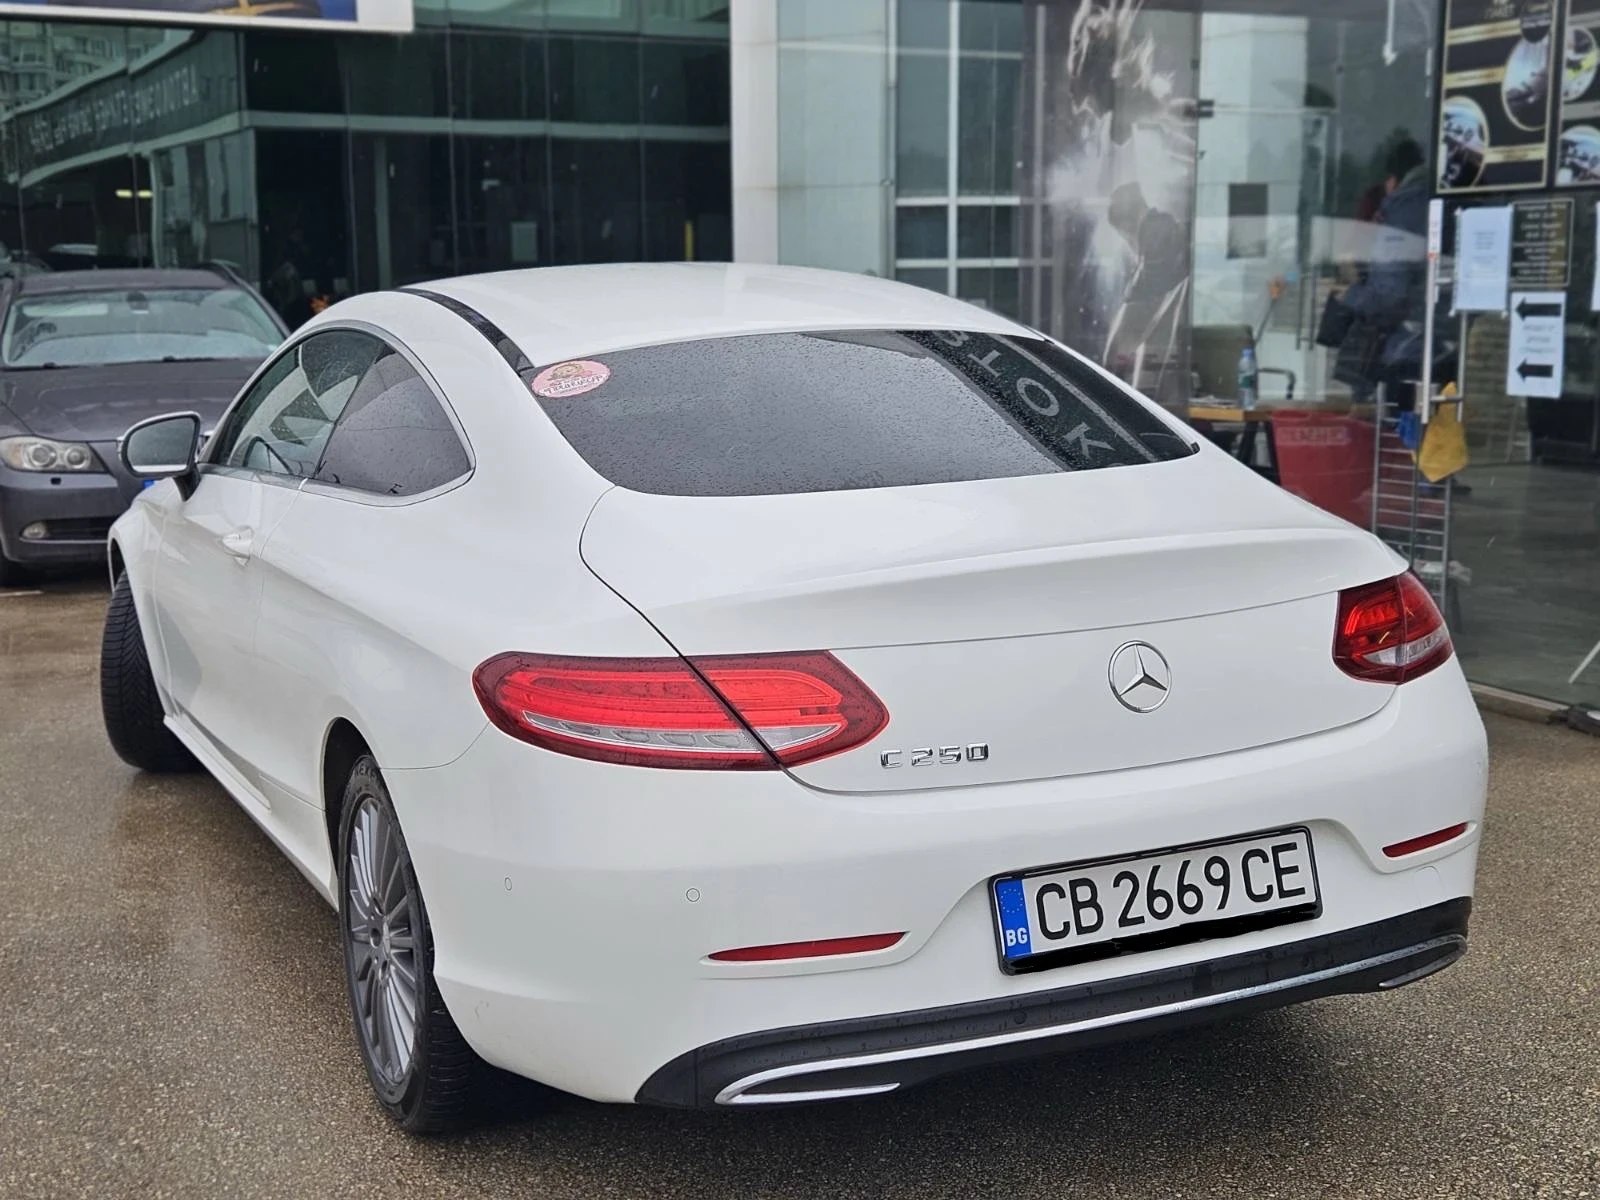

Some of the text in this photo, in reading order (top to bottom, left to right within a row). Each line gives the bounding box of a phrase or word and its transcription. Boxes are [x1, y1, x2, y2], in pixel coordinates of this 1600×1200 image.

[880, 743, 989, 769] C 250
[1035, 842, 1306, 940] CB 2669 CE
[1005, 927, 1028, 947] BG
